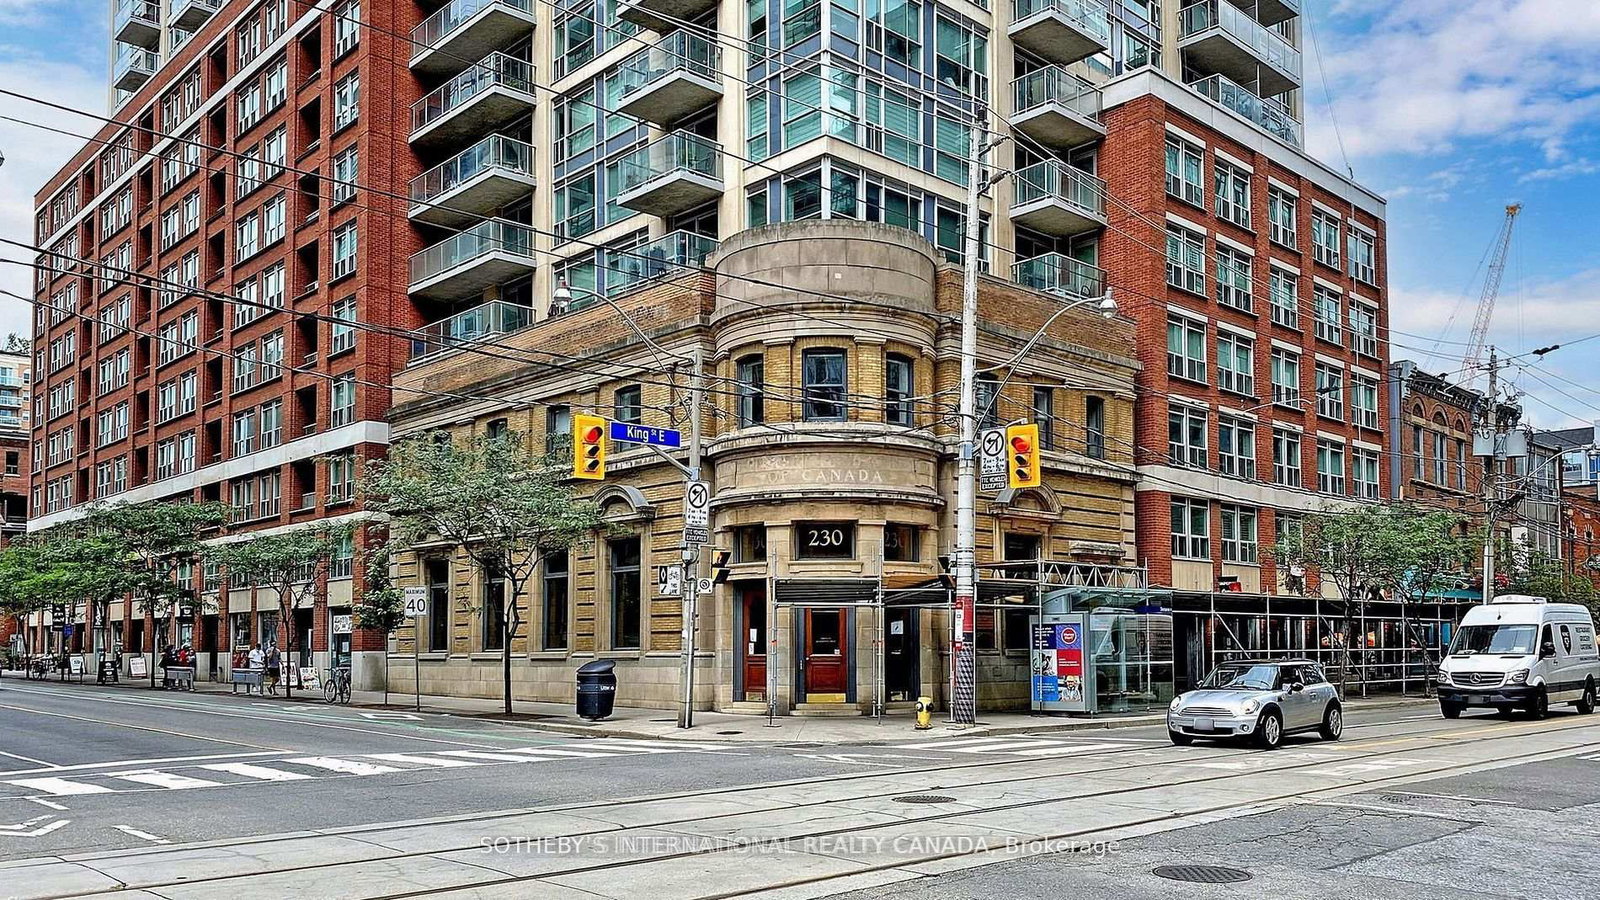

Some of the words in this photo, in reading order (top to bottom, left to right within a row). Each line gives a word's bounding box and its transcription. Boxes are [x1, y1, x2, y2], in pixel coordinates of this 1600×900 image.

[627, 425, 649, 443] King
[650, 428, 657, 436] St
[658, 430, 665, 442] E
[801, 469, 883, 482] CANADA
[808, 529, 843, 546] 230
[406, 598, 426, 612] 40
